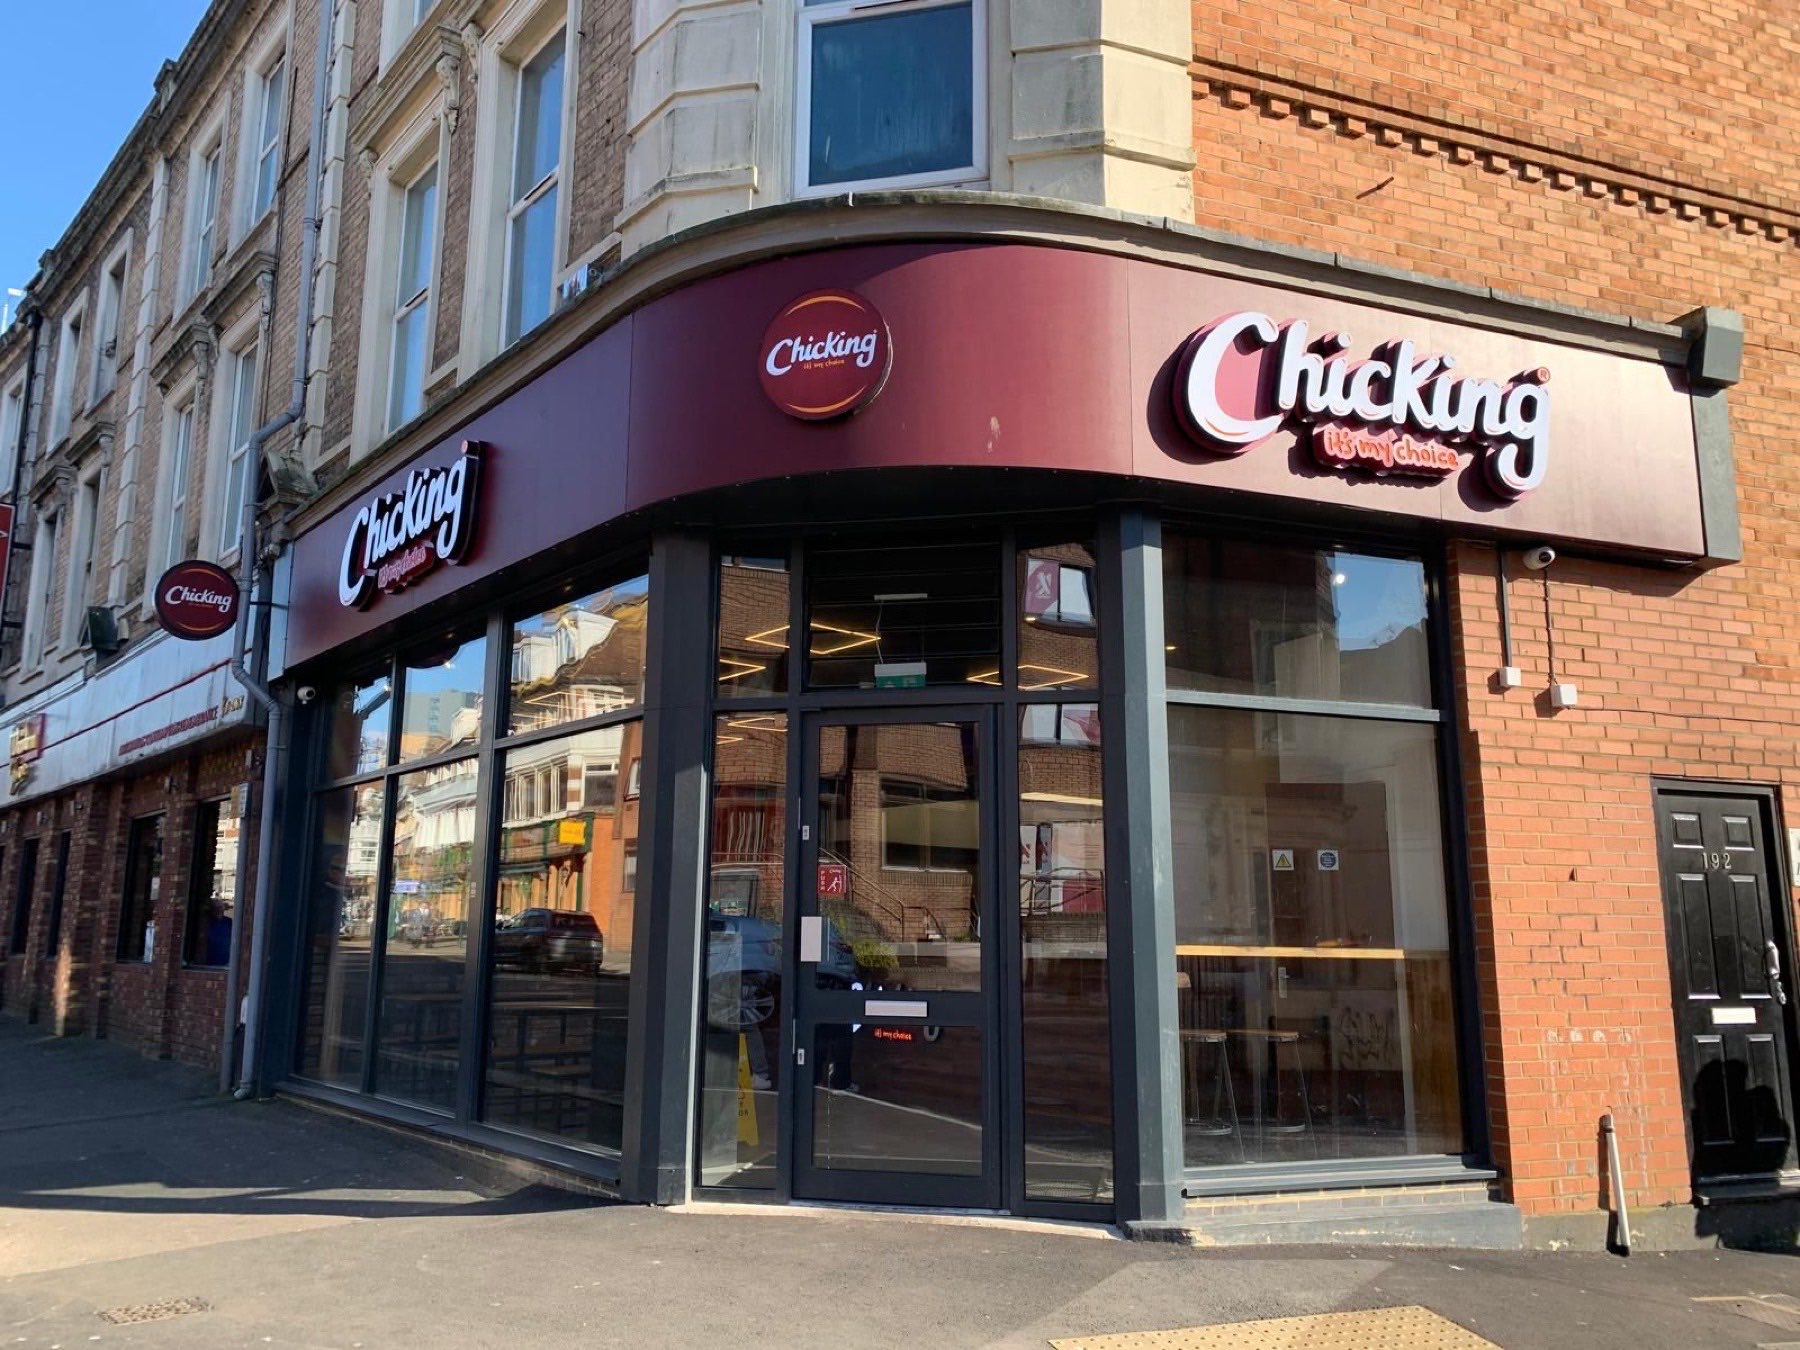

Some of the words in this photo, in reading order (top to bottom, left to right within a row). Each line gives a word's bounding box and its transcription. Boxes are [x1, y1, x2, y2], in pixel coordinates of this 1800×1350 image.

[766, 329, 877, 376] Chicking
[1187, 311, 1550, 491] Chicking
[1358, 438, 1391, 464] my
[1396, 435, 1458, 469] choice
[339, 455, 468, 607] Chicking
[164, 584, 233, 613] Chicking
[1701, 852, 1733, 871] 192
